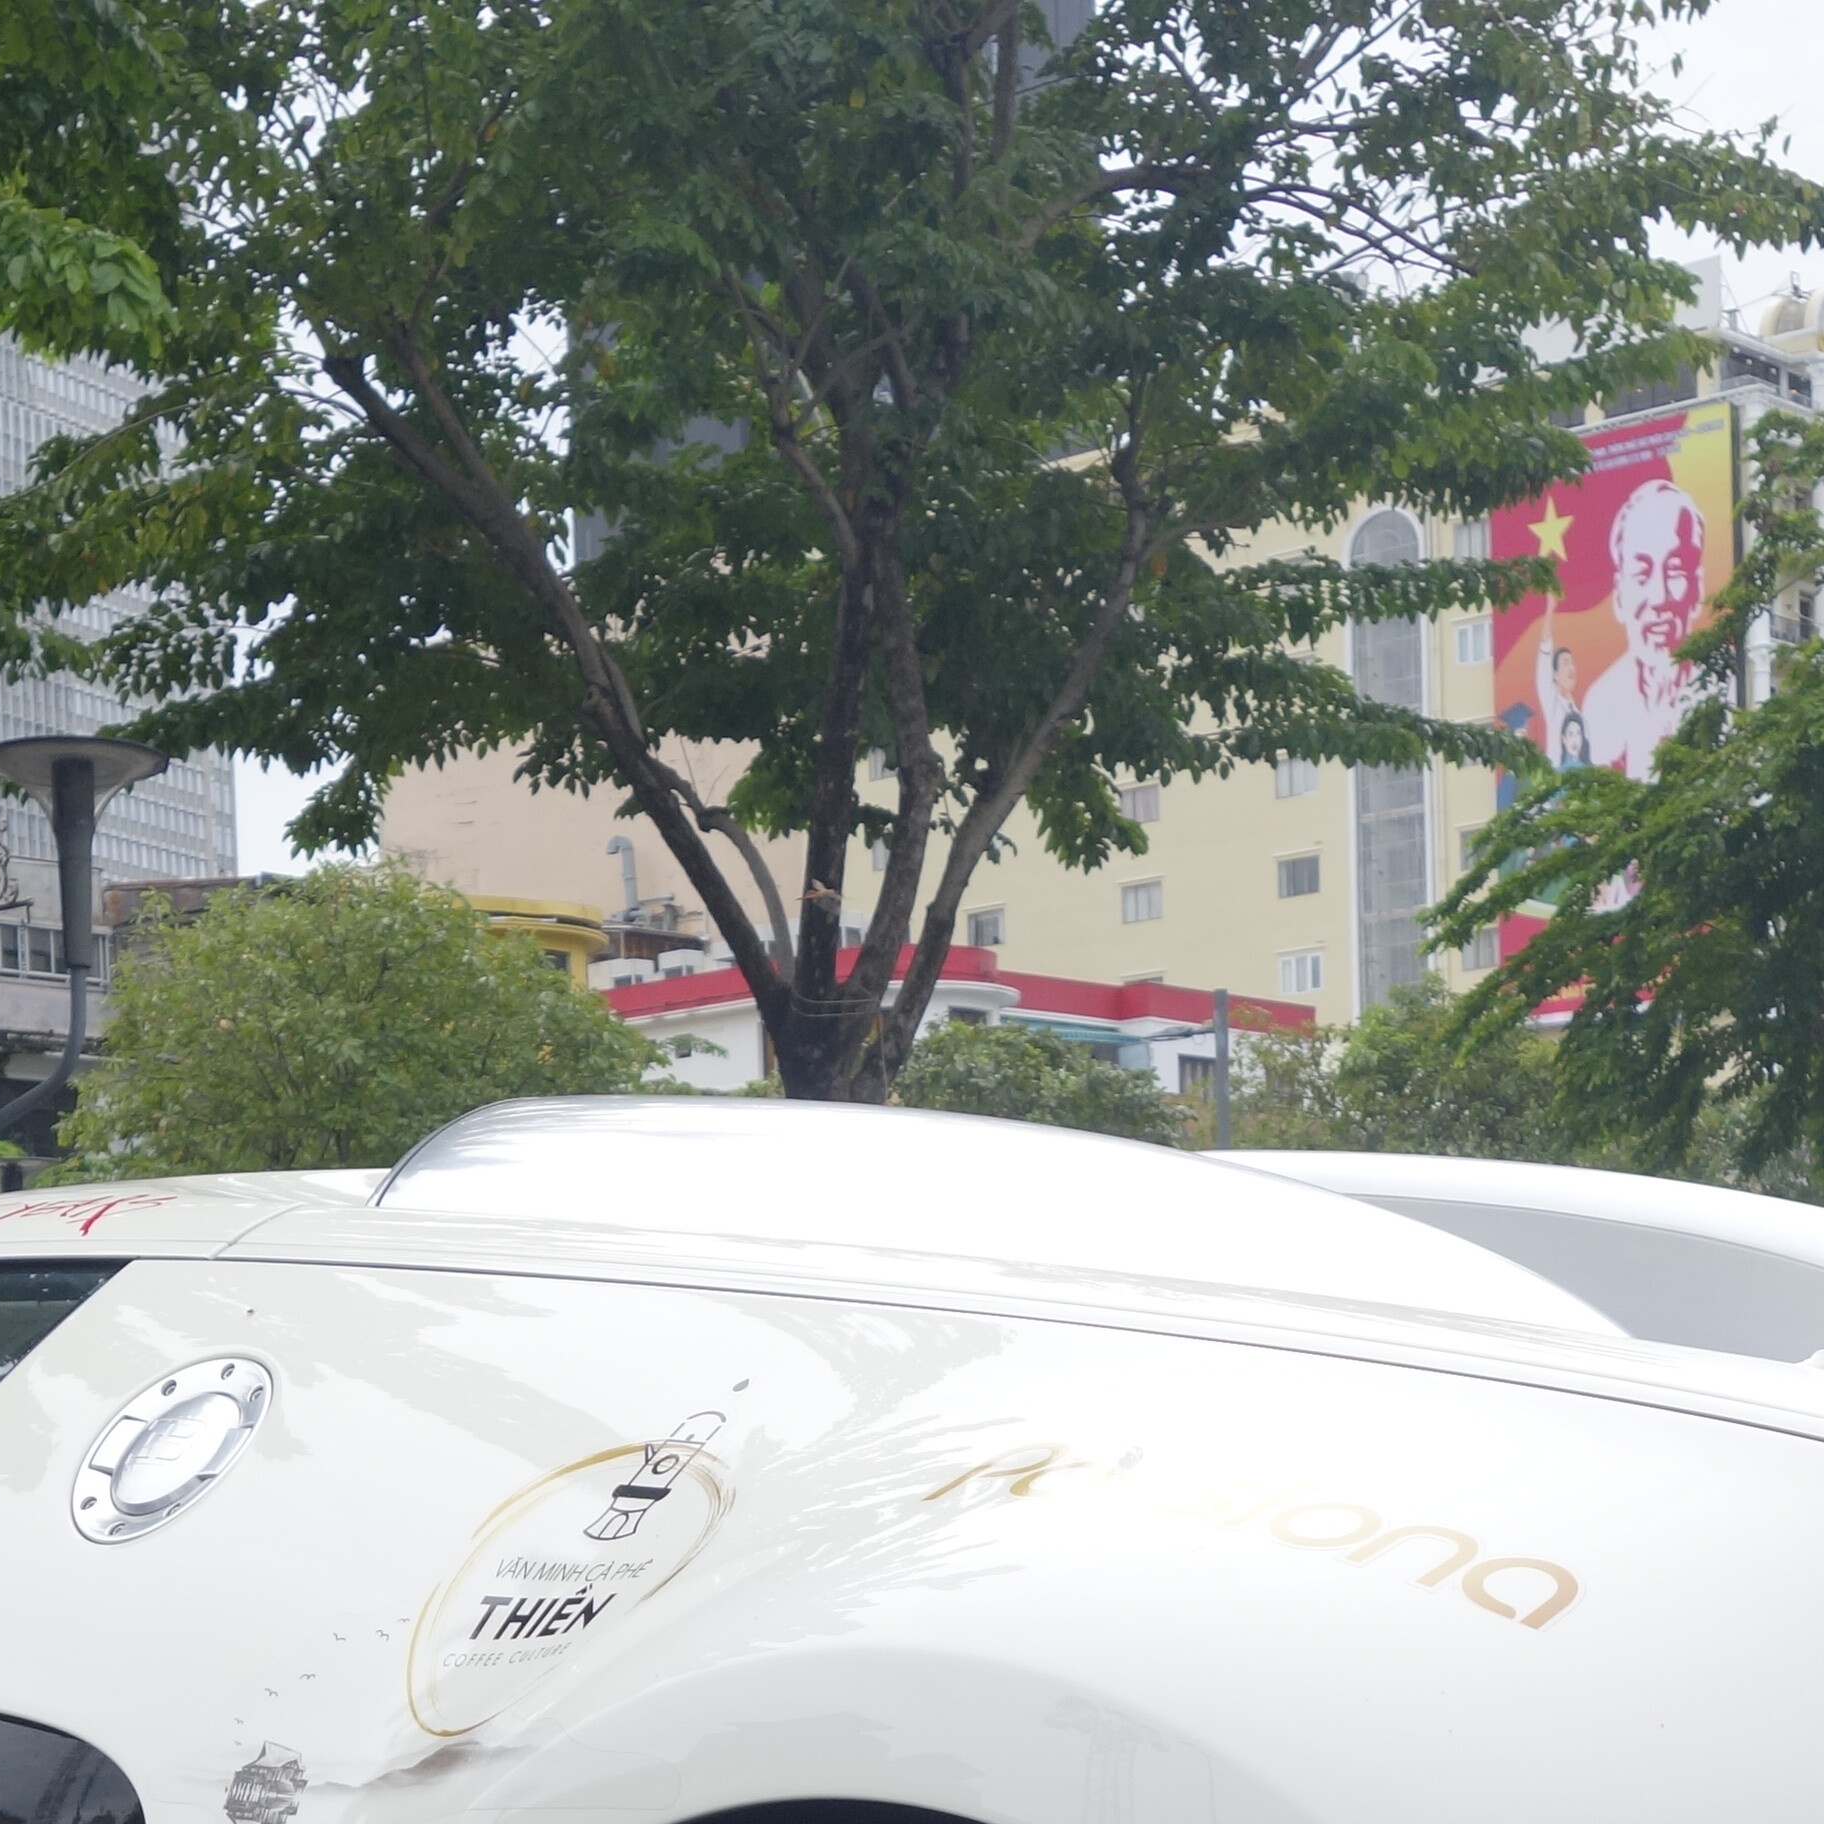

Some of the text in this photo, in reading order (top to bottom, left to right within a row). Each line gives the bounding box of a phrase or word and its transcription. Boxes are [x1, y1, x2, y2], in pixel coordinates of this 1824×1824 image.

[532, 1562, 588, 1582] MINH
[442, 1641, 572, 1668] COFFEE CULTURE
